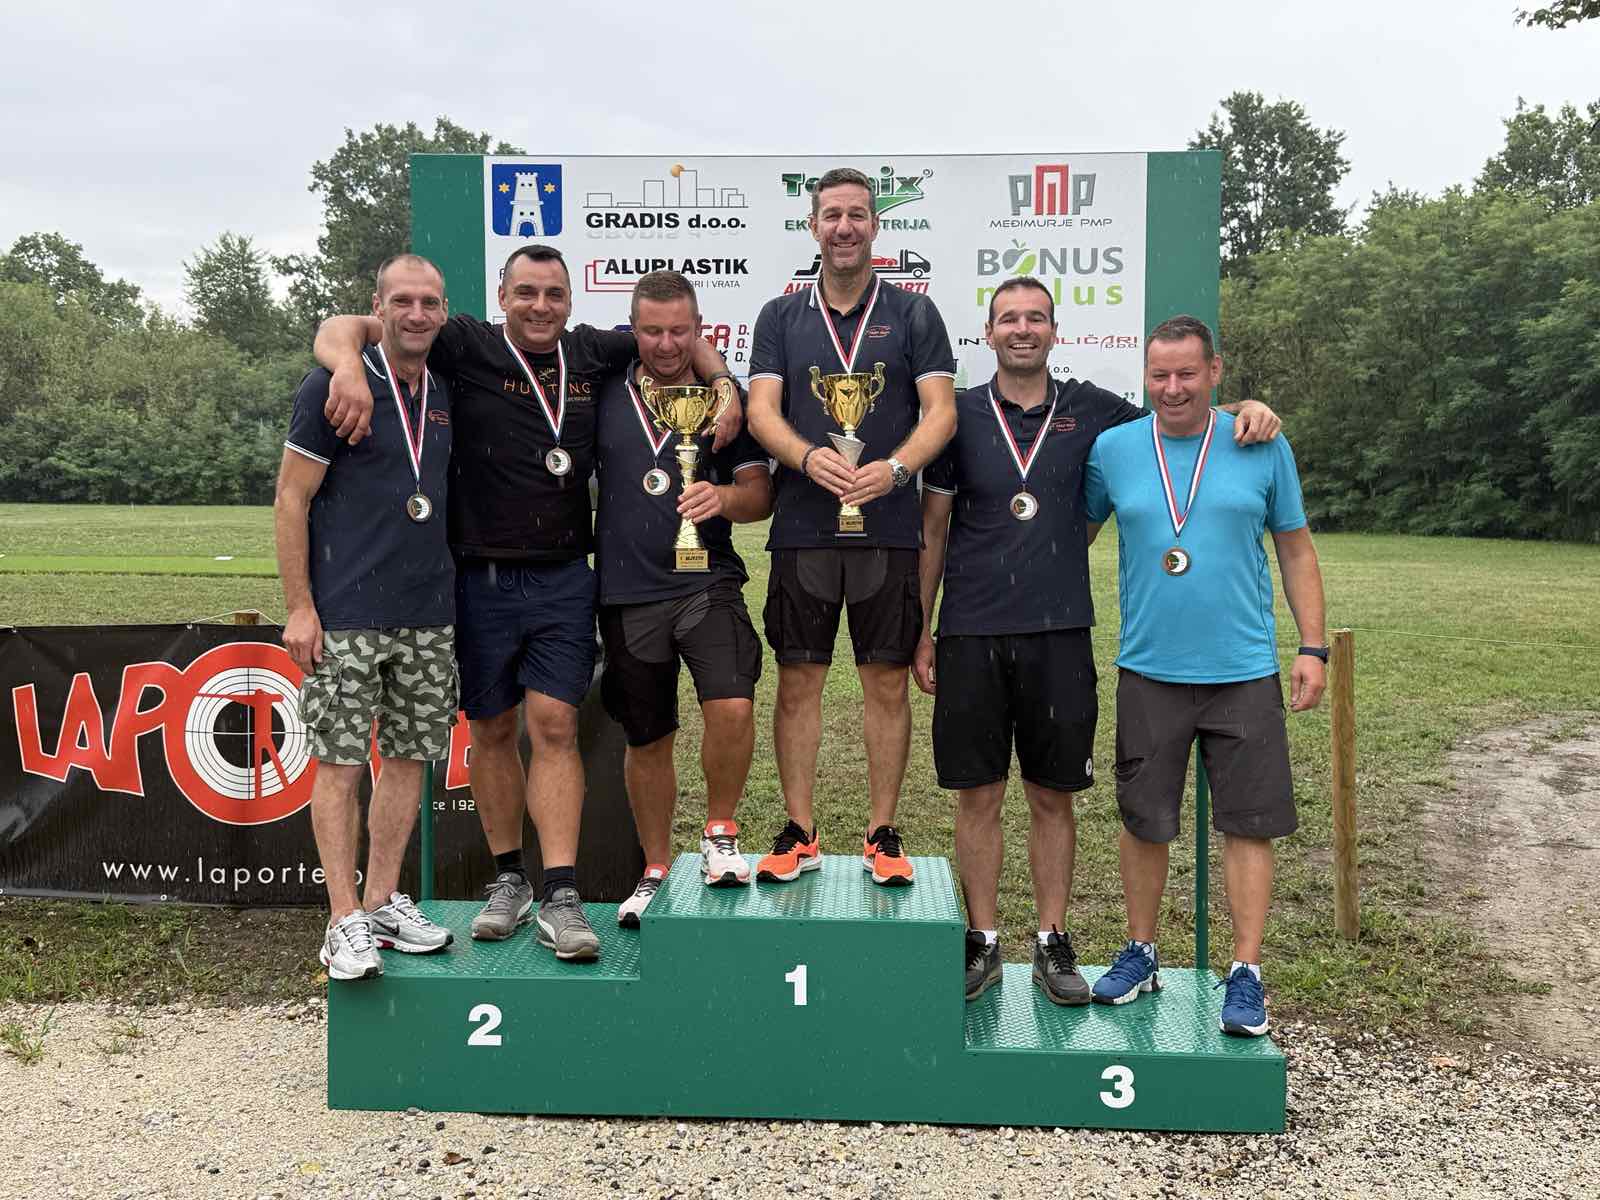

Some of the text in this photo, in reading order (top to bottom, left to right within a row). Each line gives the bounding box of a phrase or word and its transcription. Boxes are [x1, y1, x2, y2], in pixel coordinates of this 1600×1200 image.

[585, 212, 746, 229] GRADIS d.o.o.
[989, 217, 1113, 228] MEĐIMURJE PMP
[603, 258, 749, 275] ALUPLASTIK
[976, 243, 1124, 276] BONUS
[711, 279, 741, 288] VRATA
[503, 378, 592, 395] HUTNG
[451, 799, 476, 811] 192
[785, 964, 808, 1006] 1
[466, 1004, 503, 1047] 2
[1099, 1065, 1136, 1109] 3
